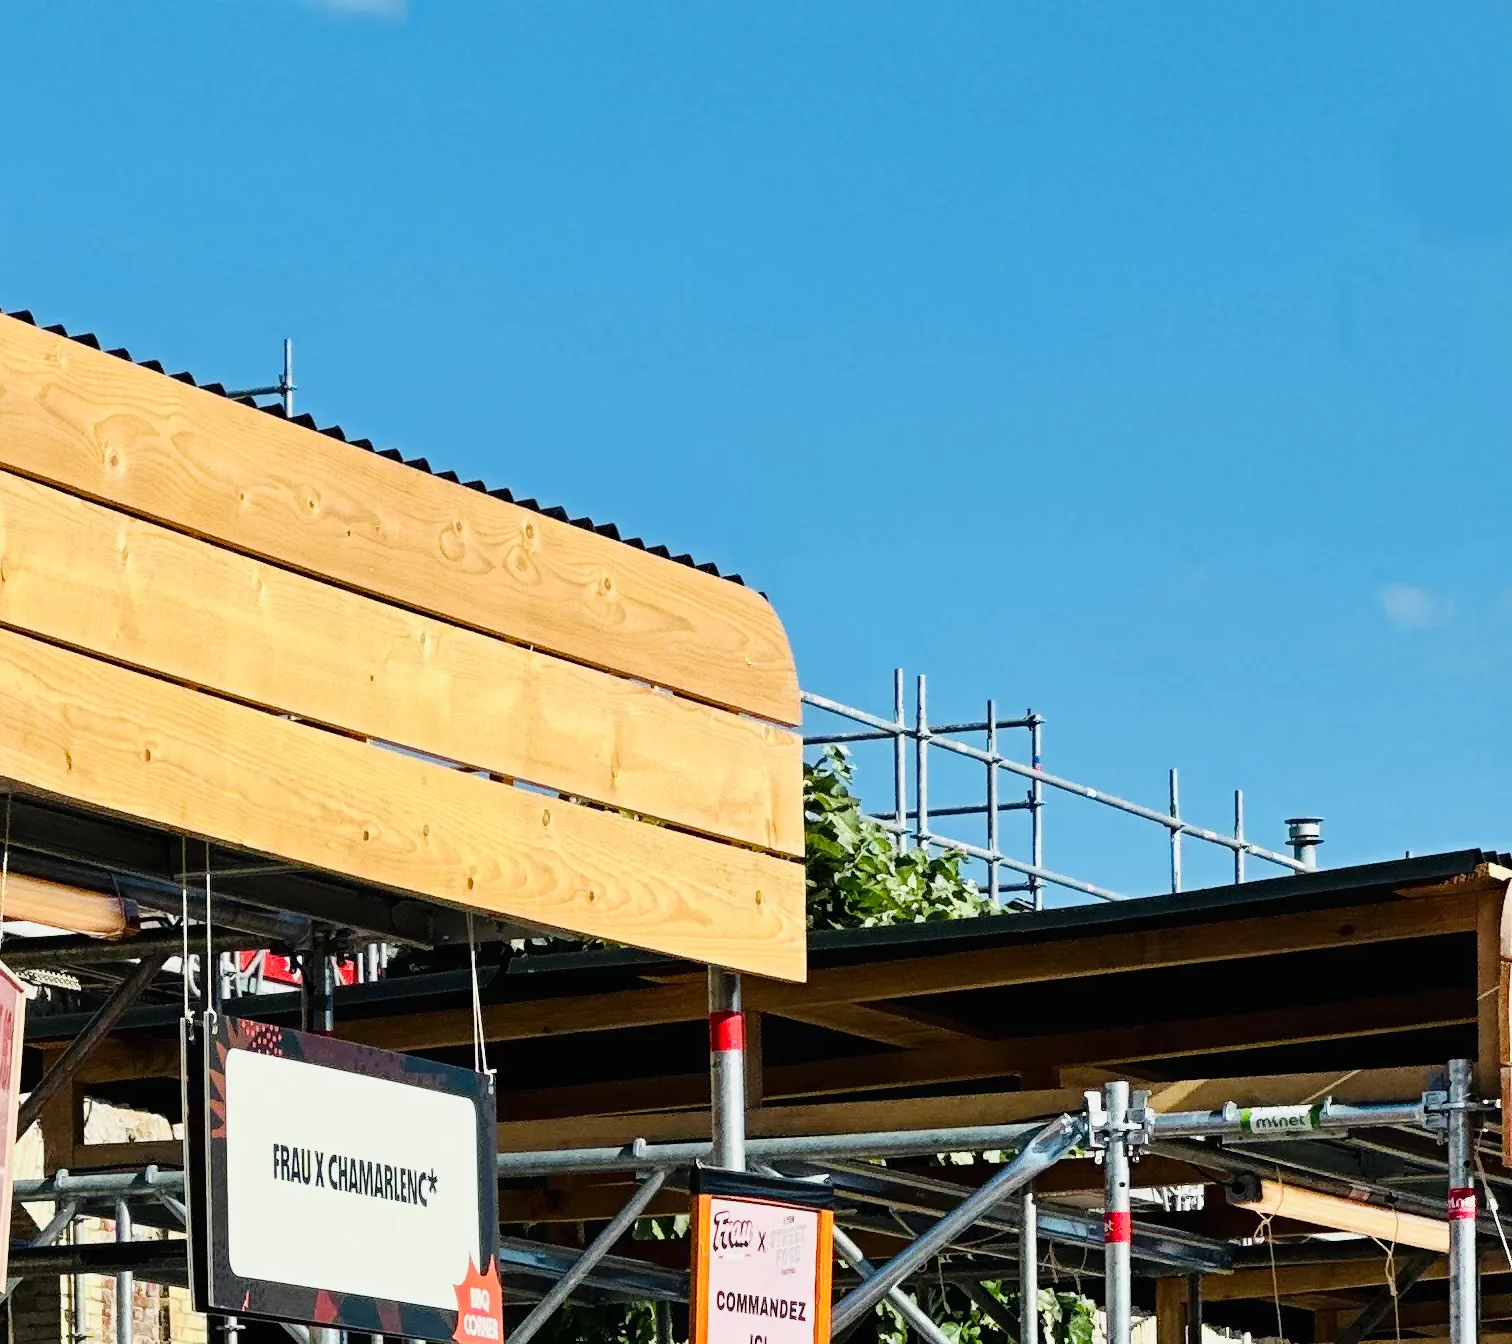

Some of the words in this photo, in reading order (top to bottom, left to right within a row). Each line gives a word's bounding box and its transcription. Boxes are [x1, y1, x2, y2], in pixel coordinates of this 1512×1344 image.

[1255, 1115, 1306, 1129] minet
[272, 1143, 312, 1187] FRAU
[314, 1151, 326, 1188] X
[716, 1290, 807, 1322] COMMANDEZ
